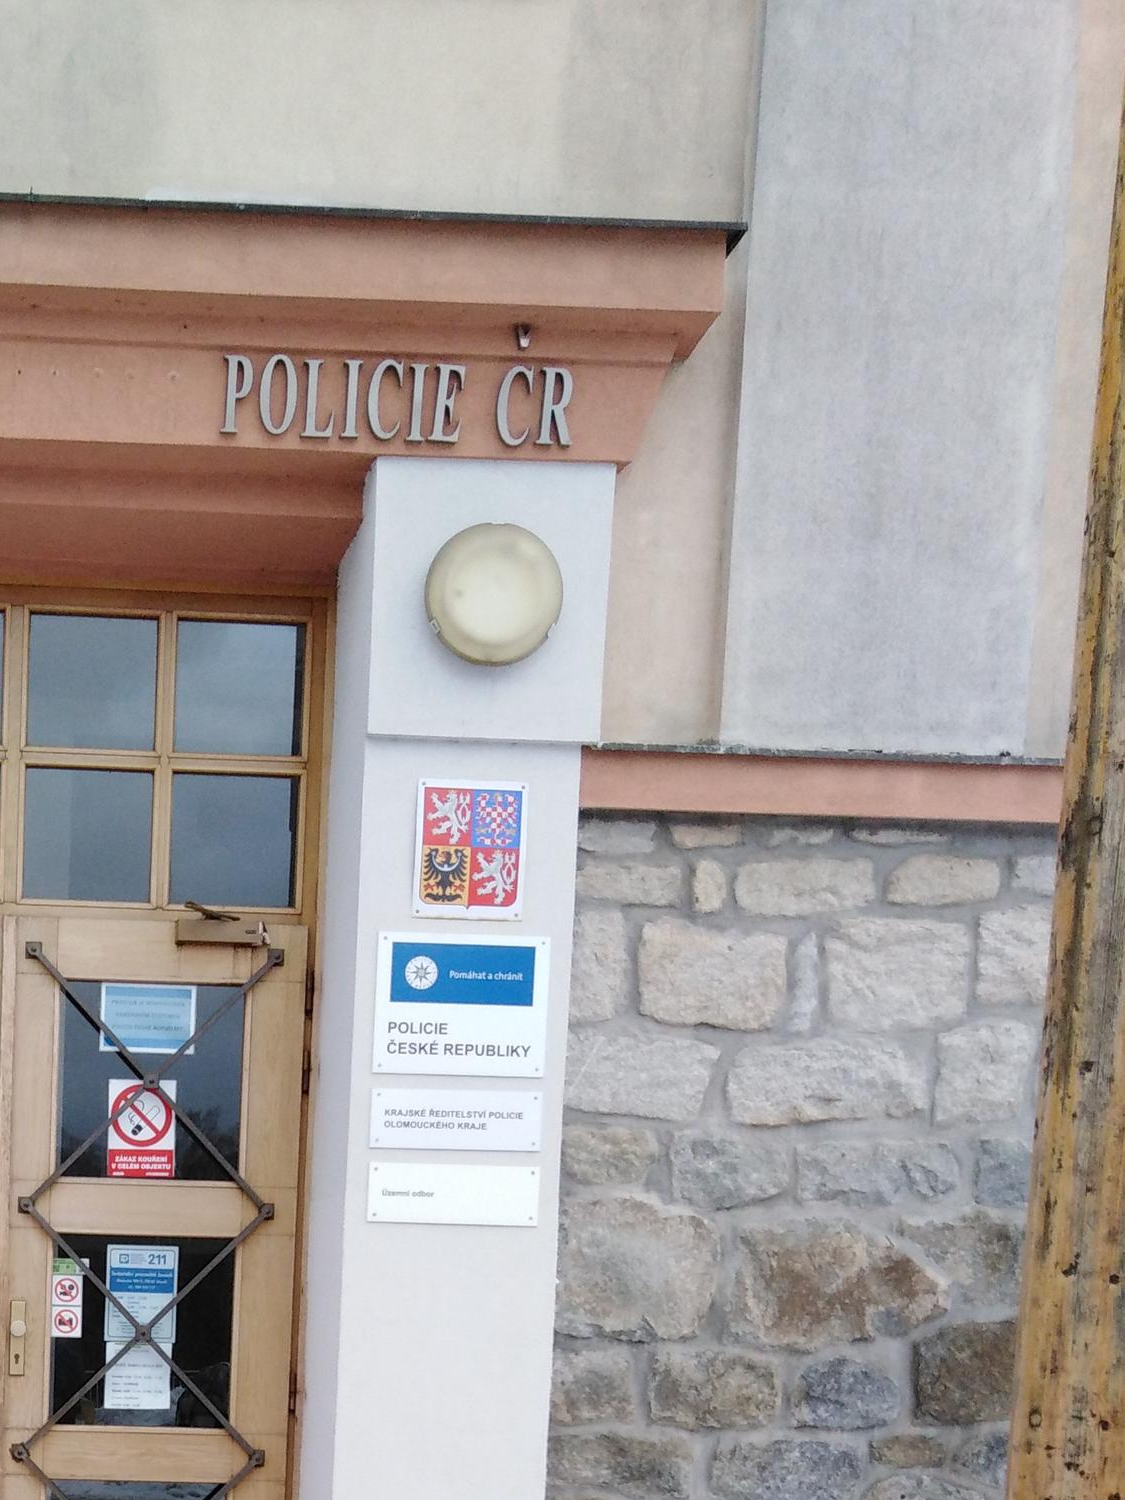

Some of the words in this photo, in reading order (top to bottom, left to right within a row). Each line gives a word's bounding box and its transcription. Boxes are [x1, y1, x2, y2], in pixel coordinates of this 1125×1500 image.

[219, 354, 467, 444] POLICIE
[449, 970, 486, 981] Pomáhat
[494, 971, 523, 981] chránit
[388, 1022, 448, 1035] POLICIE
[387, 1039, 439, 1055] ČESKÉ
[444, 1043, 531, 1058] REPUBLIKY
[384, 1108, 426, 1118] KRAJSKÉ
[429, 1108, 486, 1119] ŘEDITELSTVÍ
[489, 1112, 524, 1120] POLICIE
[115, 1154, 137, 1162] ZÁKAZ
[138, 1155, 168, 1163] KOUŘENÍ
[117, 1162, 140, 1170] CELÉM
[147, 1253, 167, 1265] 211
